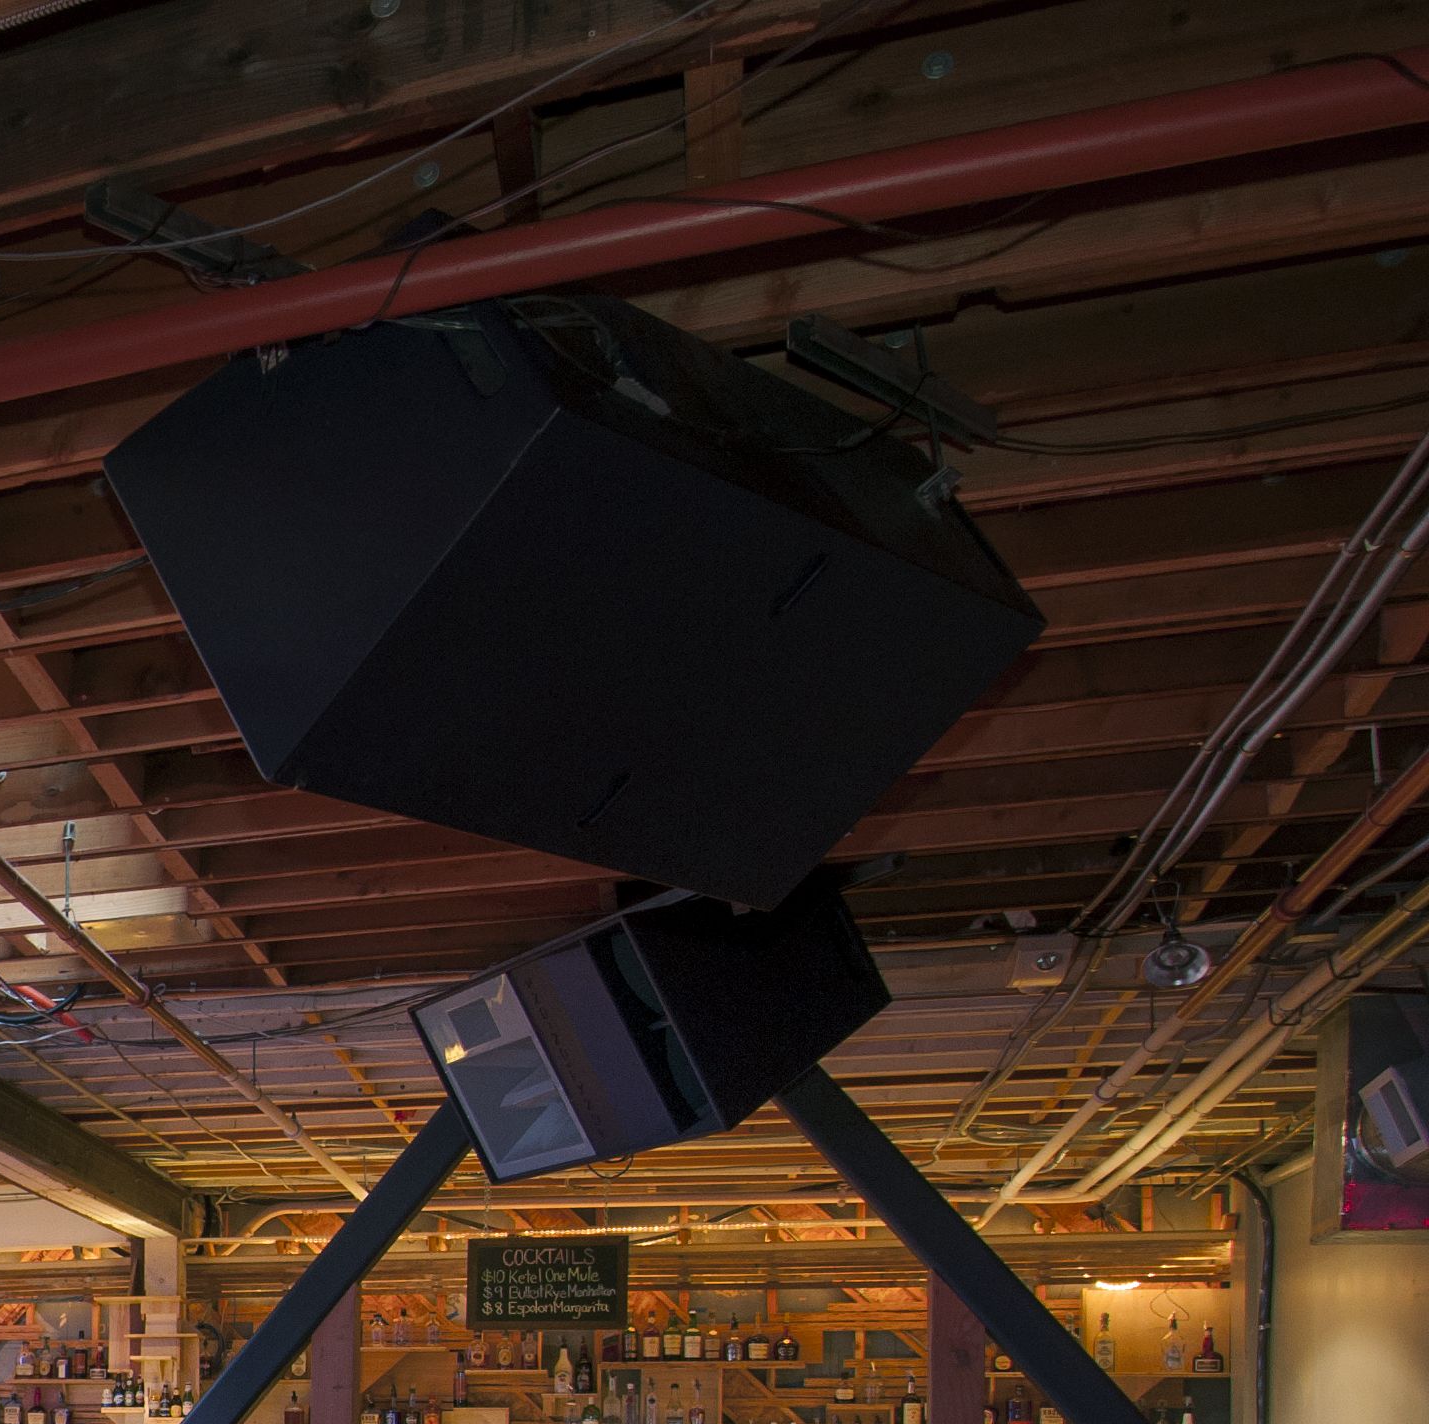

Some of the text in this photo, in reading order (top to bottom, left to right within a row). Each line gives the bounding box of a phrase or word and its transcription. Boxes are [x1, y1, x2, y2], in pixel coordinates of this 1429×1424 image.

[502, 1248, 595, 1267] COCKTAILS
[481, 1266, 600, 1286] $10 Ketel One Mule
[482, 1285, 504, 1300] $9
[545, 1284, 568, 1302] Rye
[481, 1301, 504, 1316] $8
[554, 1300, 611, 1320] Margarita
